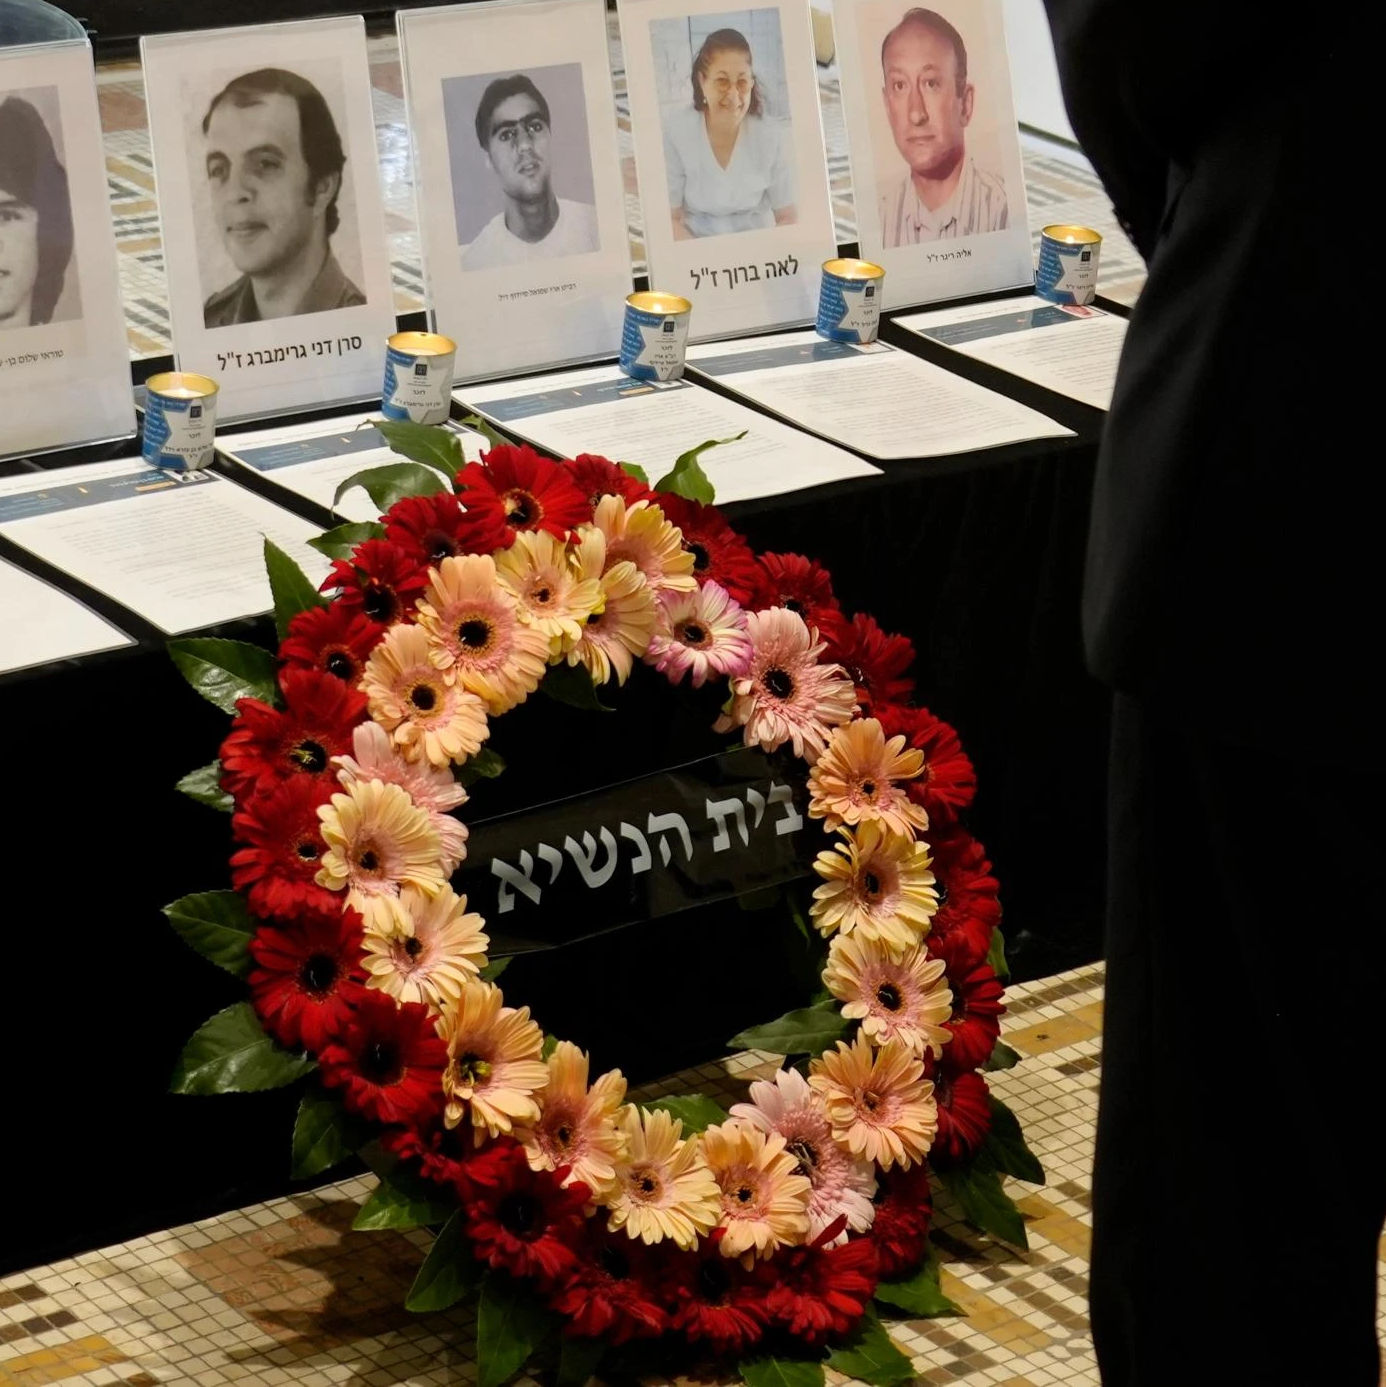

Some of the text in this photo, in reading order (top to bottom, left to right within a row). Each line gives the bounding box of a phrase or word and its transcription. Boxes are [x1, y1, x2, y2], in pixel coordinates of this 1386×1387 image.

[690, 254, 799, 290] לאה ברוך ז"ל
[217, 335, 362, 371] סרן דני גרימברג ז"ל
[491, 780, 803, 914] בית הנשיא
